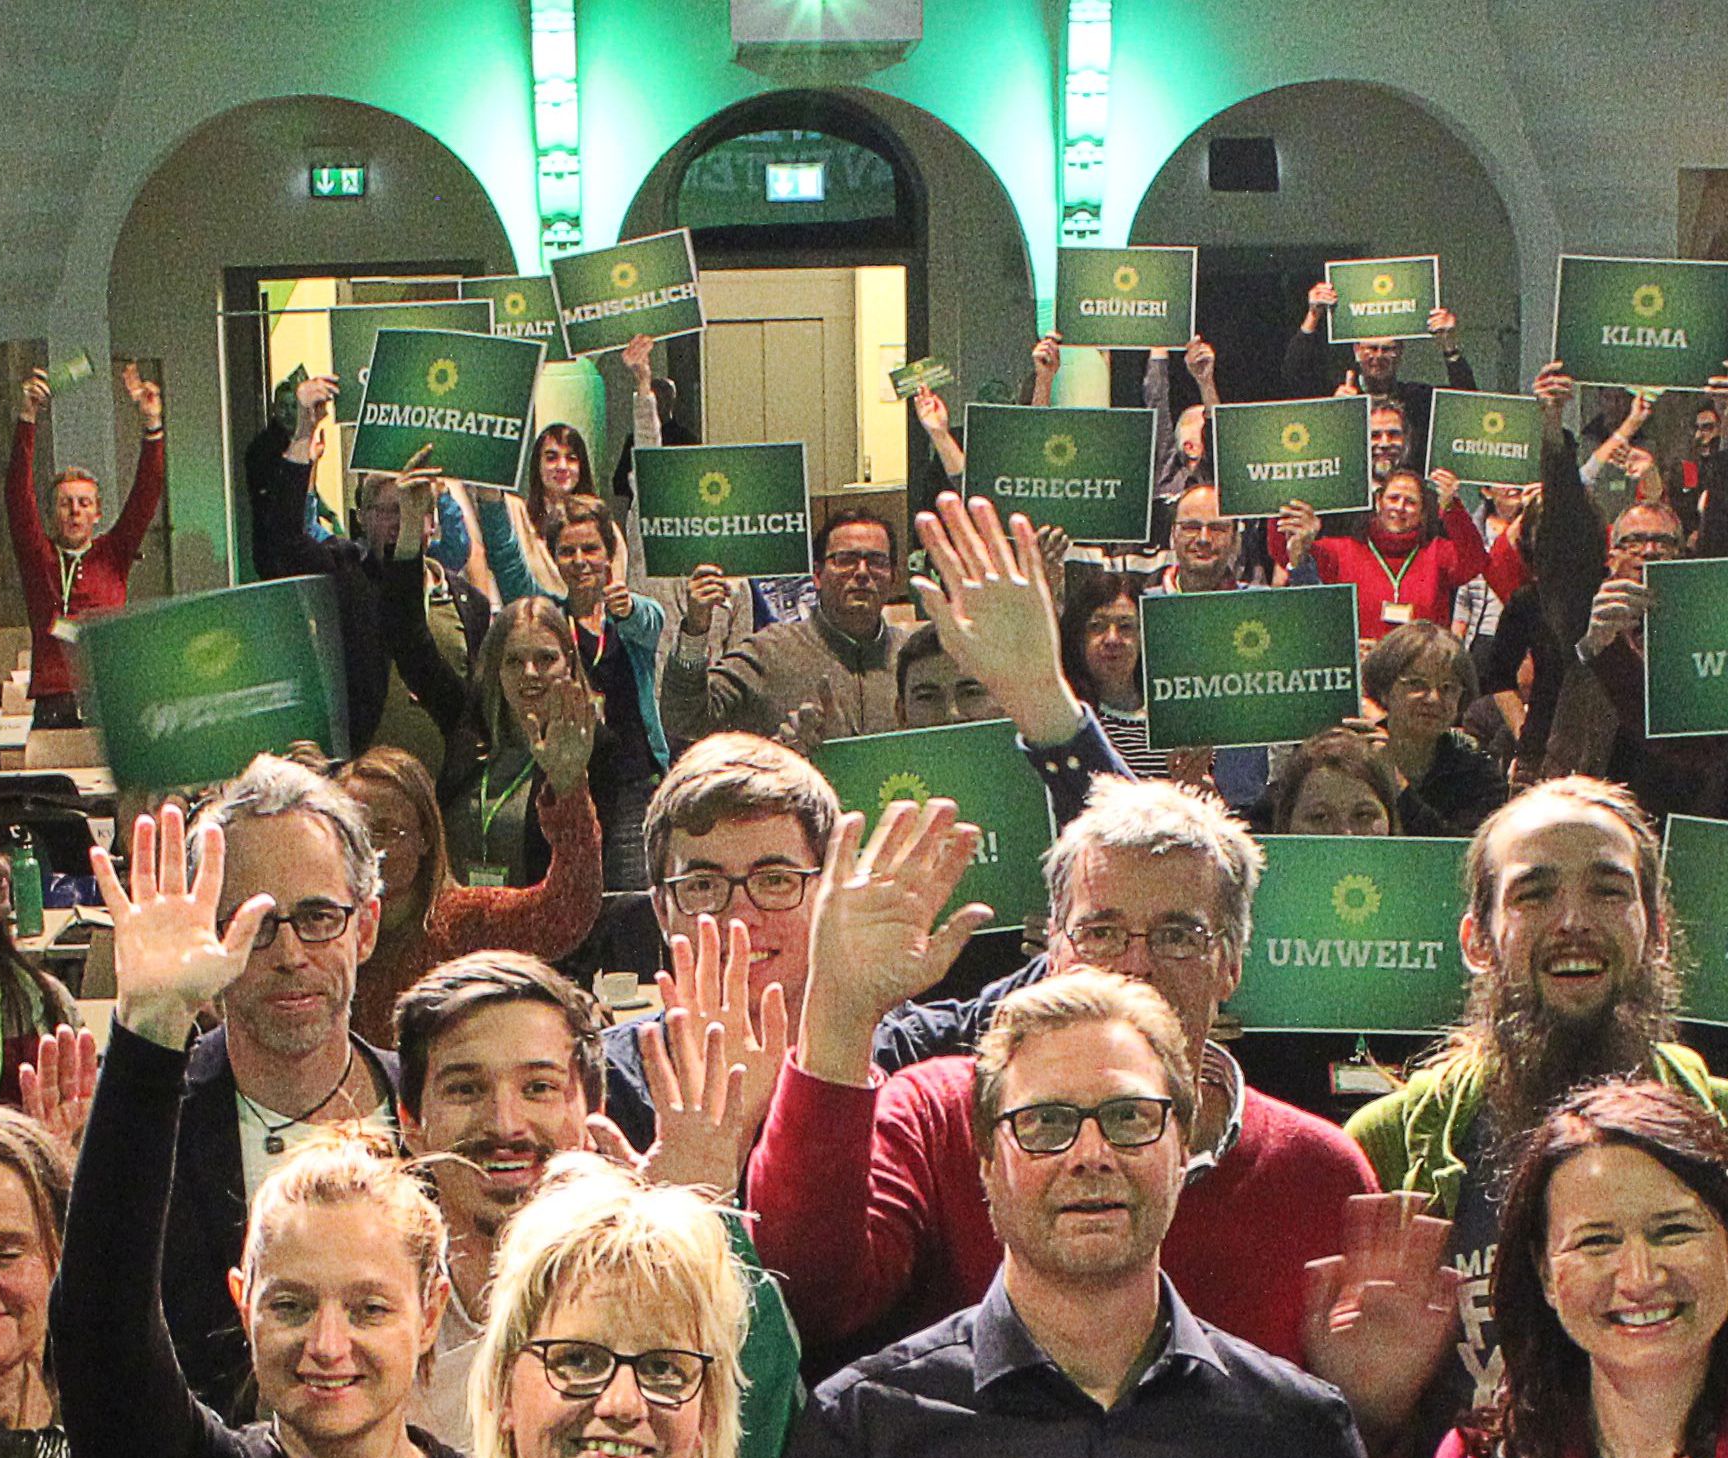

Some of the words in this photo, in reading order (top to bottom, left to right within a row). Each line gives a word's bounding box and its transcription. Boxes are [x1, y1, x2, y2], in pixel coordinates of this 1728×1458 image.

[563, 284, 697, 325] MENSCHLICH
[1080, 298, 1167, 317] GRÜNER!
[1349, 300, 1415, 316] WEITER!
[496, 321, 556, 337] ELFALT
[1602, 326, 1687, 348] KLIMA
[363, 402, 522, 441] DEMOKRATIE
[1452, 439, 1528, 459] GRÜNER!
[1247, 457, 1339, 481] WEITER!
[994, 475, 1122, 500] GERECHT
[640, 512, 805, 537] MENSCHLICH
[1154, 667, 1352, 700] DEMOKRATIE
[1267, 939, 1443, 969] UMWELT
